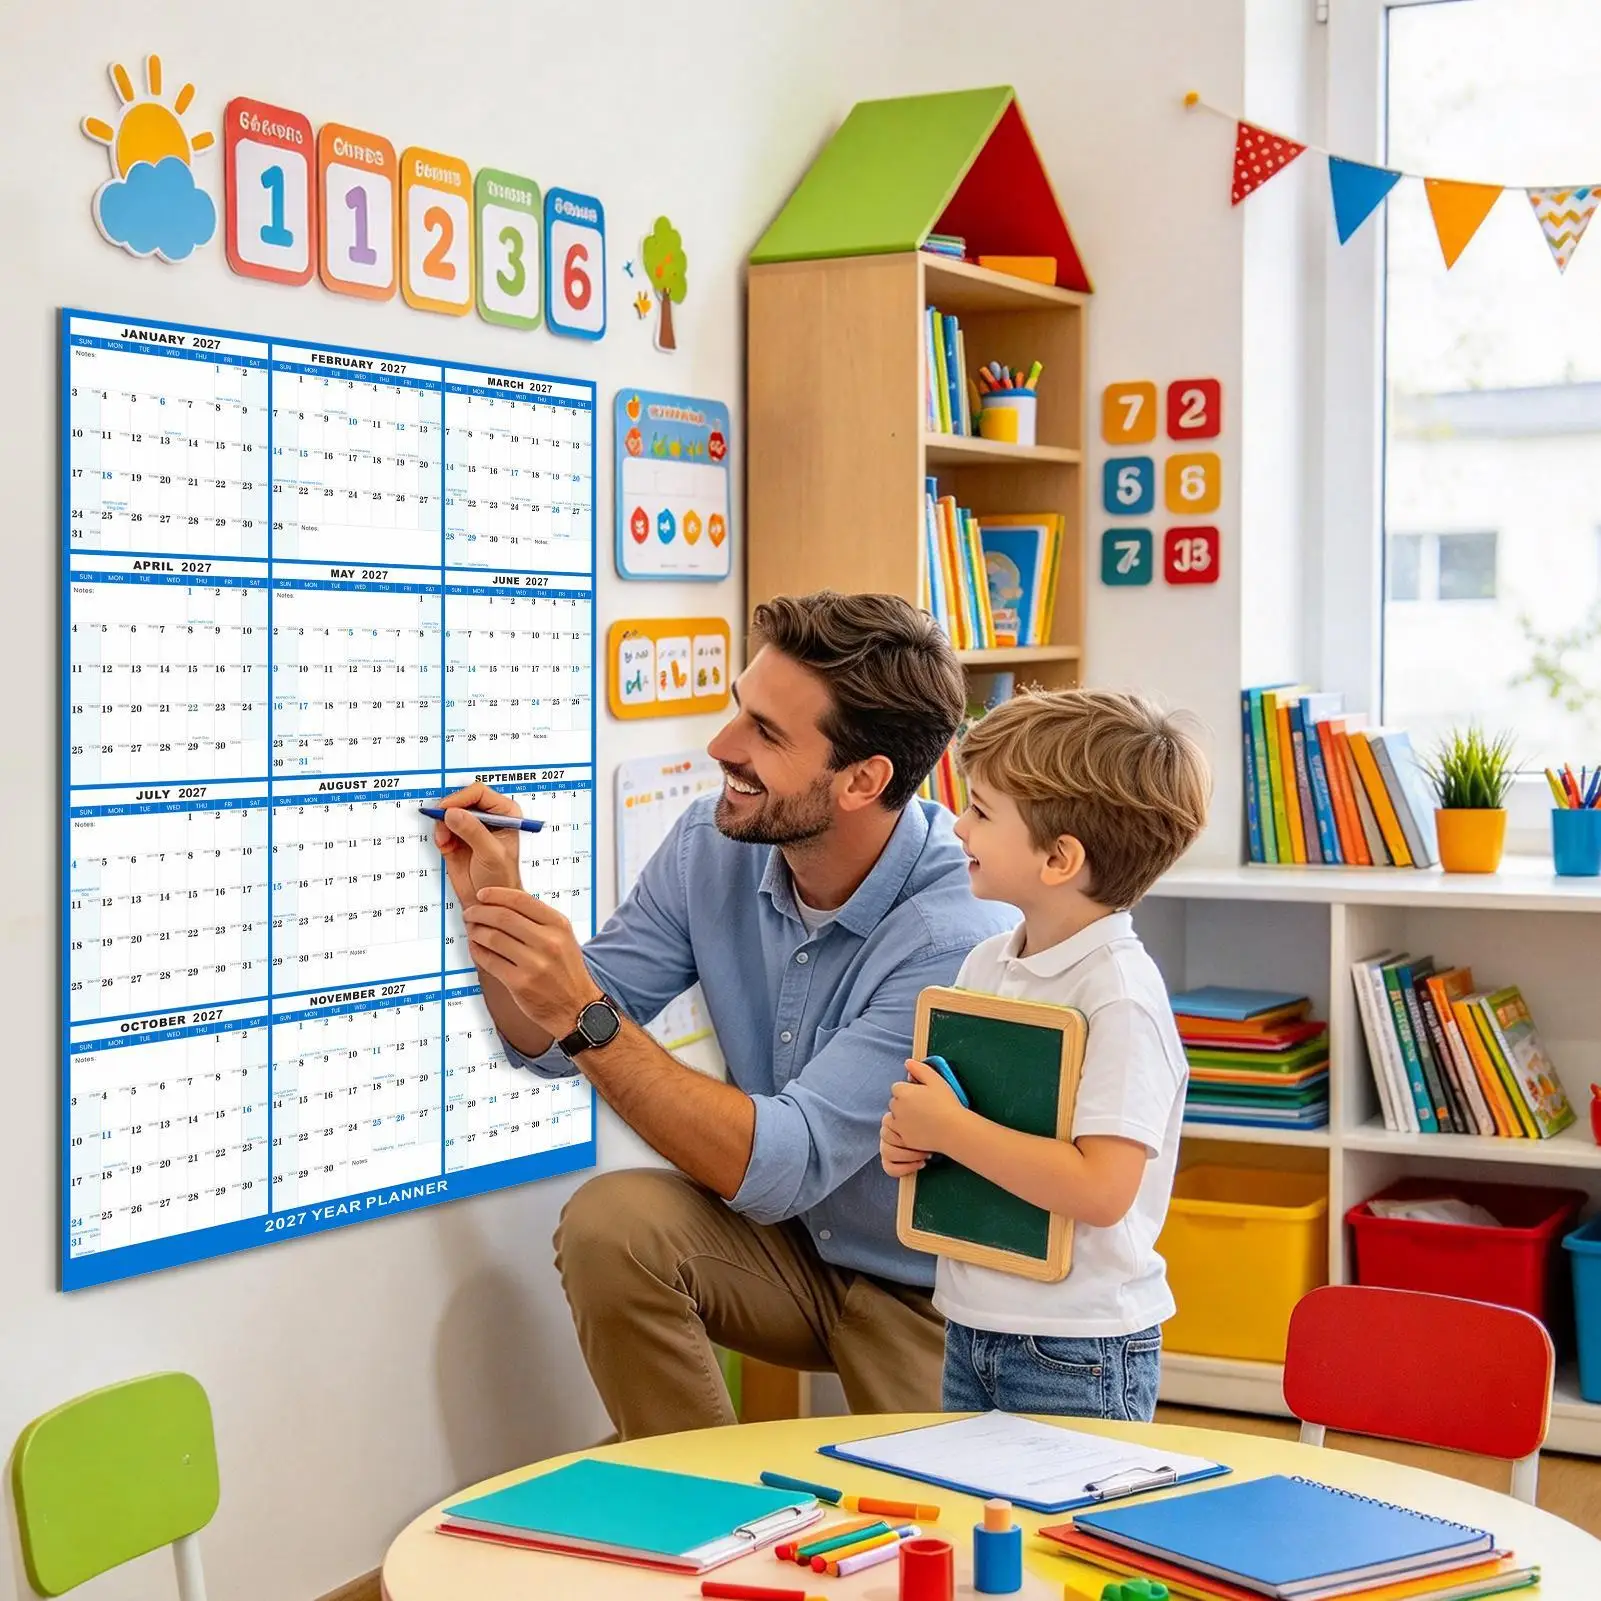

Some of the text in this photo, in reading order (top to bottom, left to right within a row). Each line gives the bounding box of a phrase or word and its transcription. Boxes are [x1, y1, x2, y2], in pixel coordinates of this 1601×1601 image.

[260, 164, 294, 248] 1
[344, 184, 377, 266] 1
[422, 205, 456, 282] 2
[496, 224, 526, 296] 3
[562, 242, 592, 312] 6
[121, 328, 220, 350] JANUARY 2027
[312, 354, 406, 374] FEBRUARY 2027
[488, 377, 552, 393] MARCH 2027
[1118, 394, 1144, 432] 7
[1178, 388, 1208, 428] 2
[349, 417, 358, 426] 10
[373, 420, 381, 429] 11
[419, 425, 428, 433] 13
[1180, 464, 1206, 501] 6
[133, 560, 212, 572] APRIL 2027
[331, 569, 388, 580] MAY 2027
[492, 576, 548, 586] JUNE 2027
[72, 664, 82, 673] 11
[102, 664, 113, 673] 12
[132, 664, 142, 673] 13
[160, 665, 170, 673] 14
[216, 665, 226, 673] 16
[242, 665, 252, 673] 17
[299, 665, 309, 673] 10
[319, 778, 400, 791] AUGUST 2027
[475, 770, 564, 782] SEPTEMBER 2027
[136, 787, 206, 800] JULY 2027
[325, 841, 334, 850] 10
[349, 840, 357, 848] 11
[373, 837, 382, 846] 12
[419, 834, 428, 842] 14
[532, 860, 540, 868] 16
[552, 858, 560, 866] 17
[71, 885, 252, 910] 11 12 13 14 15 16 17
[552, 888, 580, 900] 24 25
[310, 984, 406, 1006] NOVEMBER 2027
[120, 1010, 223, 1032] OCTOBER 2027
[273, 1074, 429, 1109] 14 15 16 17 18 19 20
[445, 1079, 580, 1113] 19 20 21 22 23 24 25
[71, 1105, 252, 1147] 10 11 12 13 14 15 16
[265, 1180, 448, 1232] 2027 YEAR PLANNER
